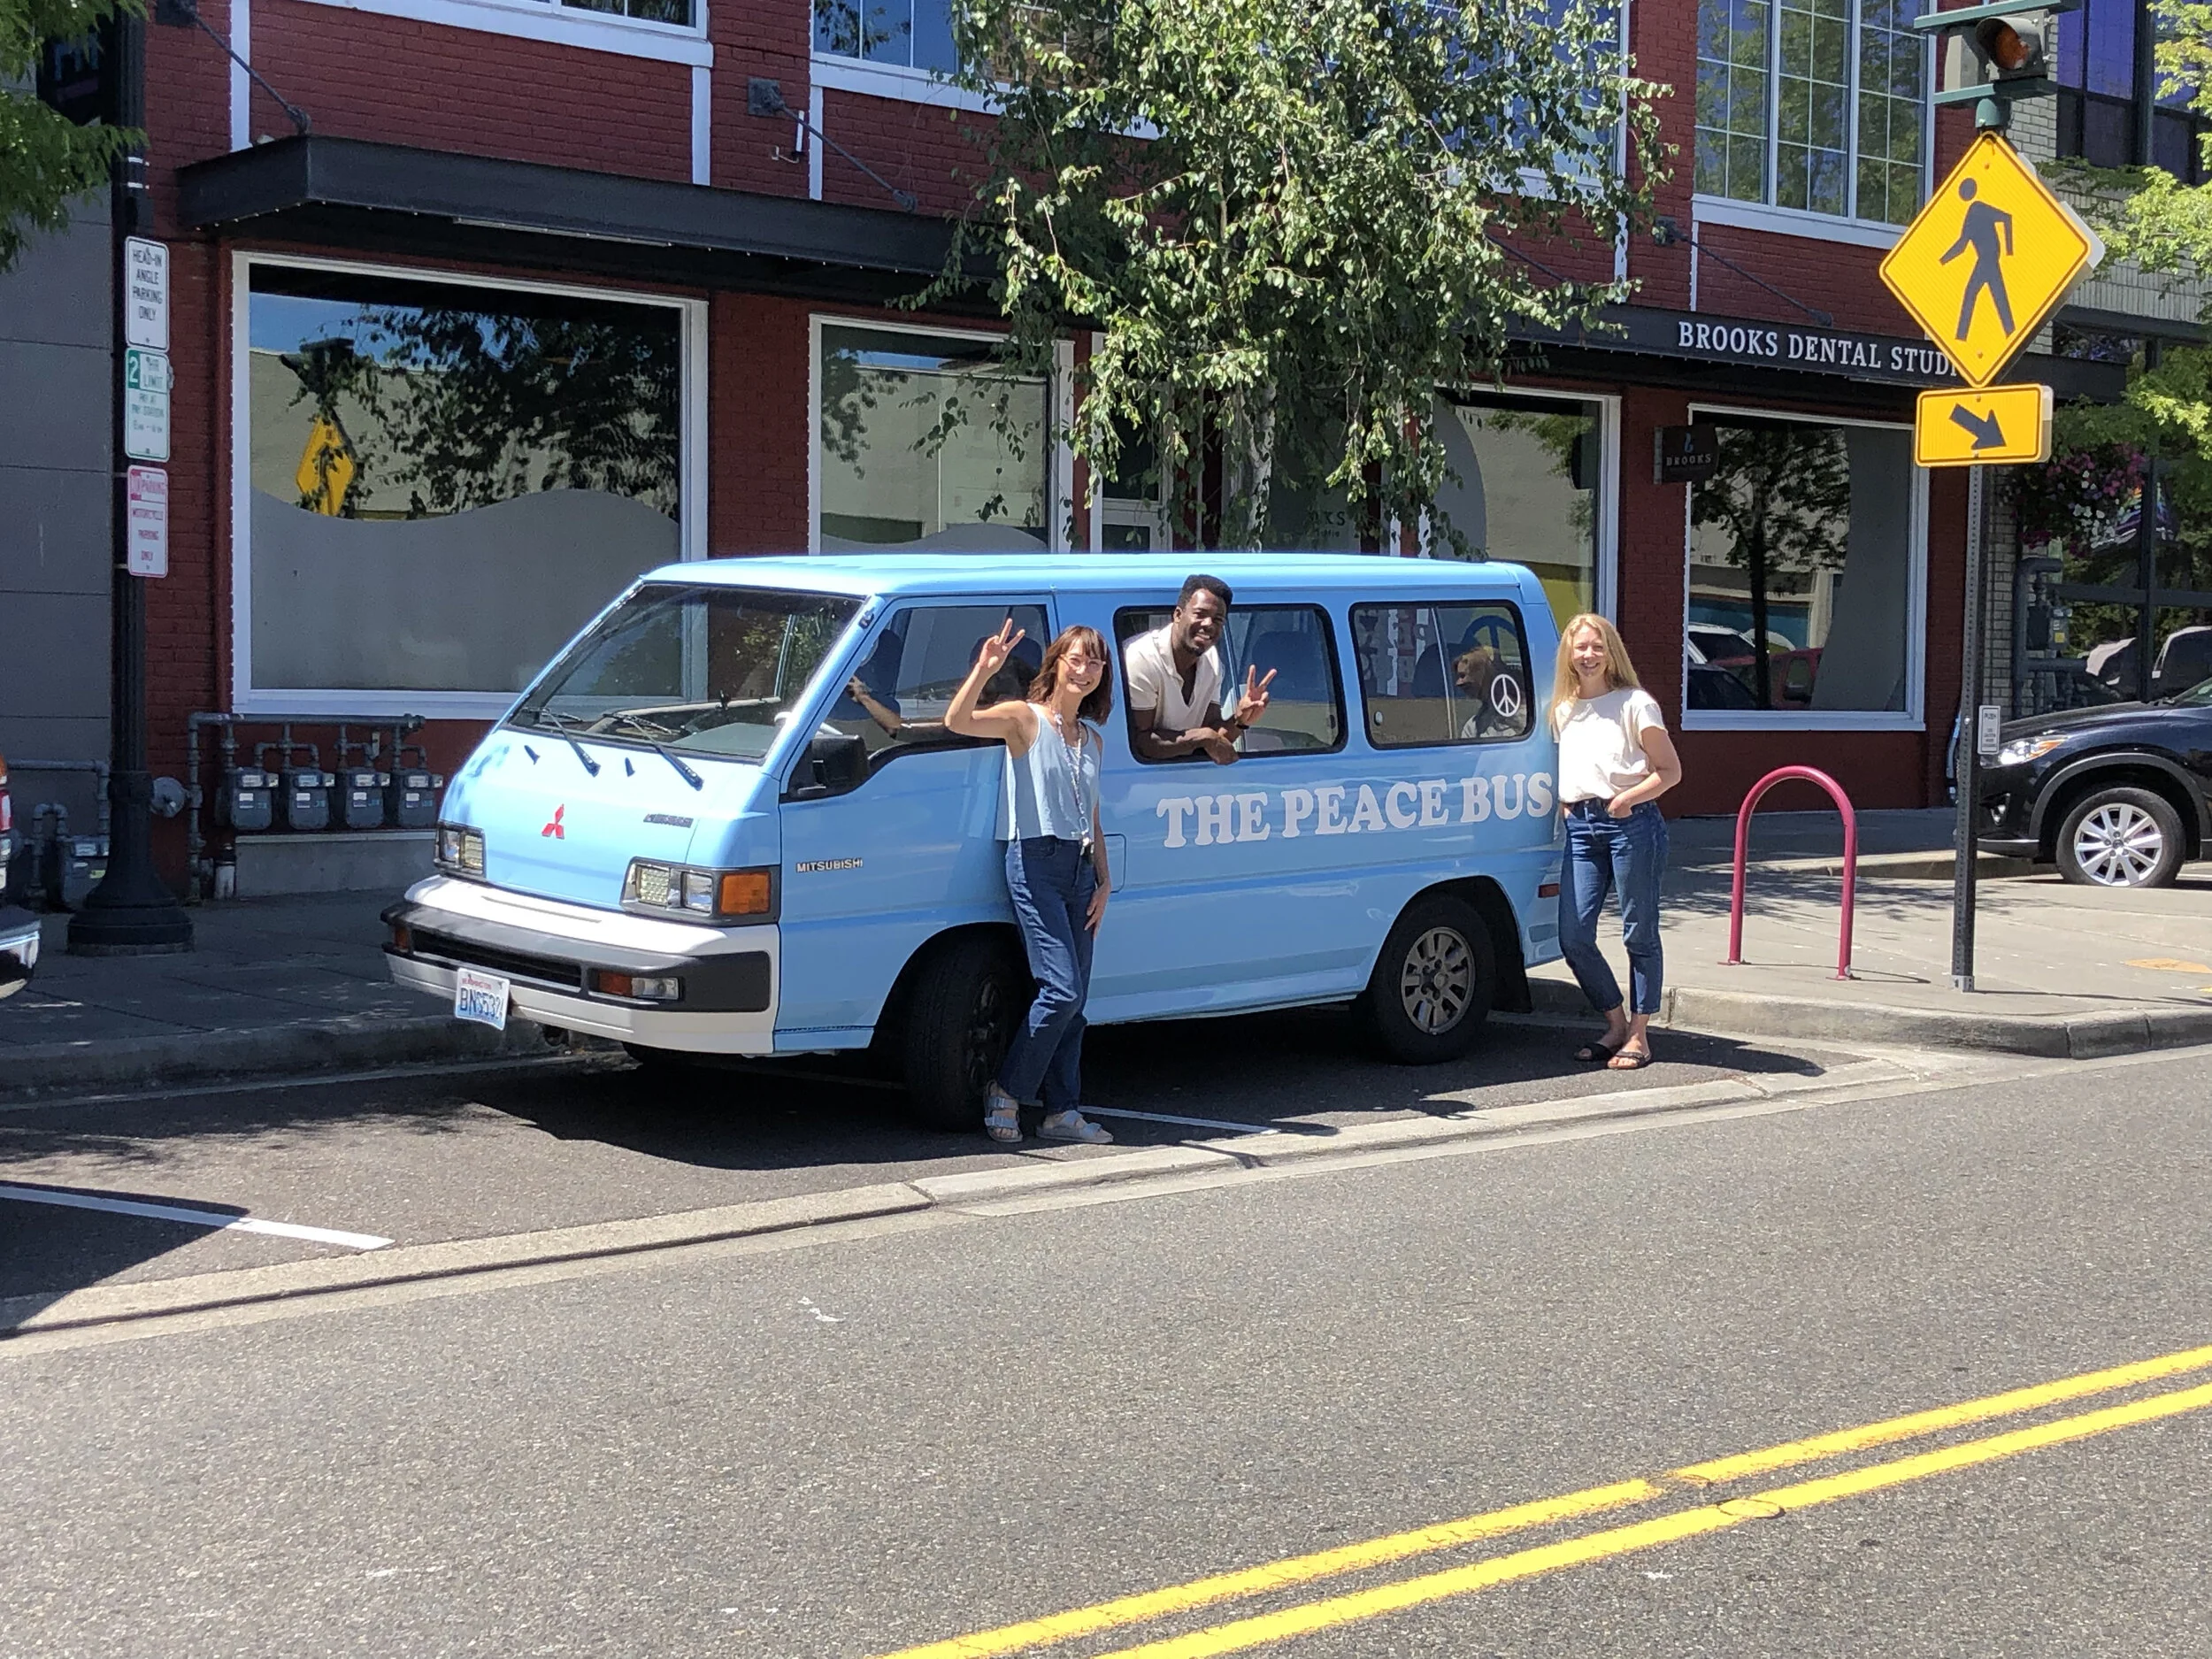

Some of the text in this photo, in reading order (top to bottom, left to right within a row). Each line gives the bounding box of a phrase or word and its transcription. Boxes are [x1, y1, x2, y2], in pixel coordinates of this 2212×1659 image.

[133, 249, 162, 267] HEAD-IN
[135, 268, 159, 285] ANGLE
[132, 286, 164, 304] PARKING
[138, 305, 157, 321] ONLY
[1678, 321, 1957, 377] BROOKS DENTAL STUDI
[128, 356, 140, 383] 2
[142, 373, 164, 390] LIMIT
[1665, 452, 1712, 467] BROOKS
[1156, 771, 1554, 849] THE PEACE BUS
[795, 856, 864, 874] MITSUBISHI
